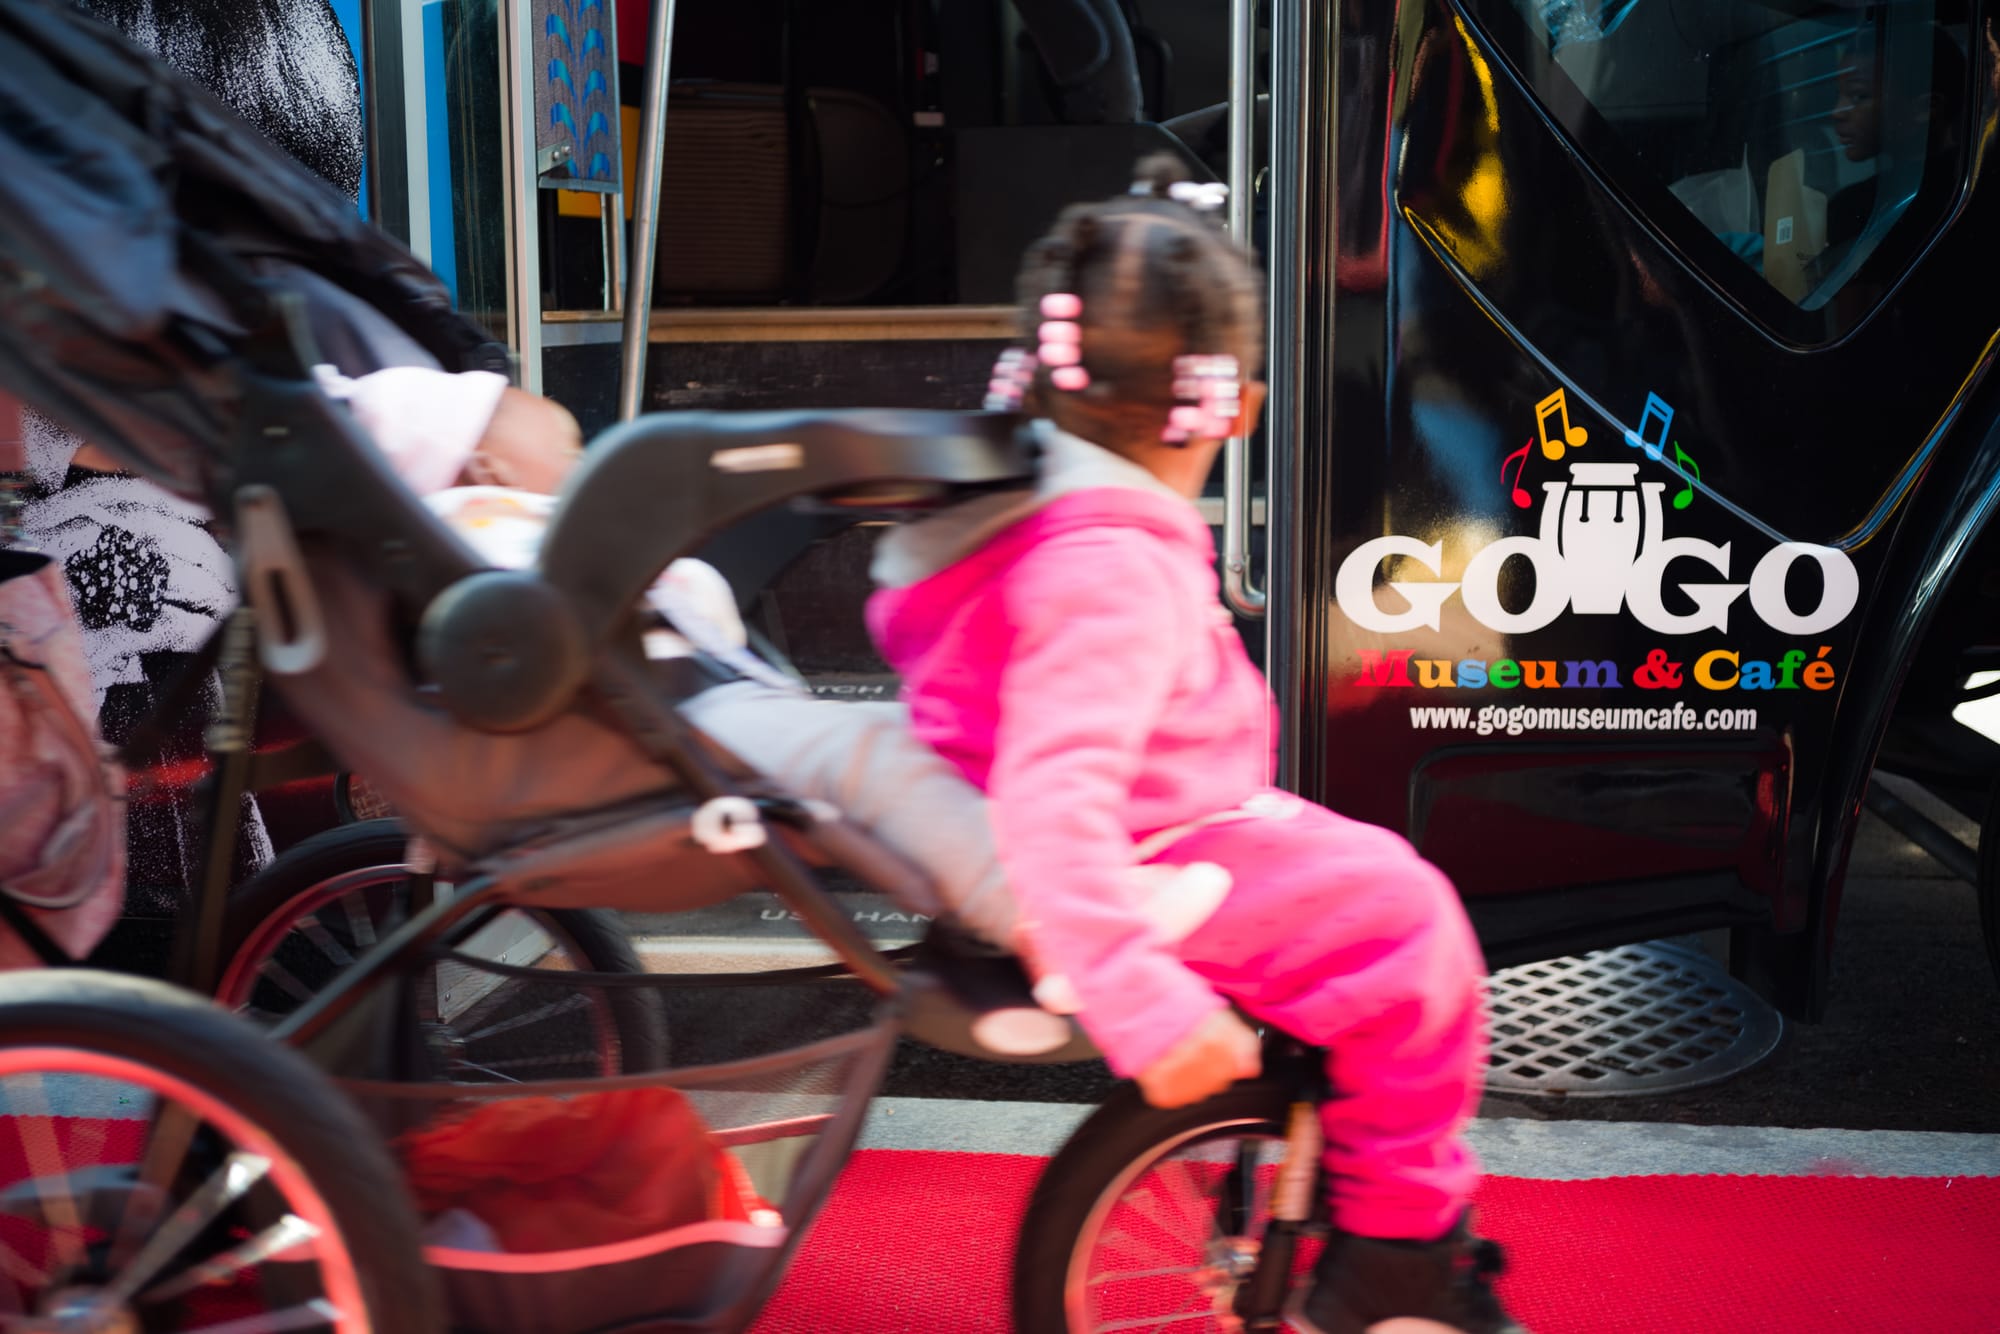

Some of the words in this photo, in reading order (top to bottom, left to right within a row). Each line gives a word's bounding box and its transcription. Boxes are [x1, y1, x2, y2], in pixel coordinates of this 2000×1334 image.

[1353, 649, 1624, 689] Museum
[1633, 648, 1683, 690] &
[1694, 646, 1836, 690] Café
[1410, 703, 1757, 735] www.gogomuseumcafe.com
